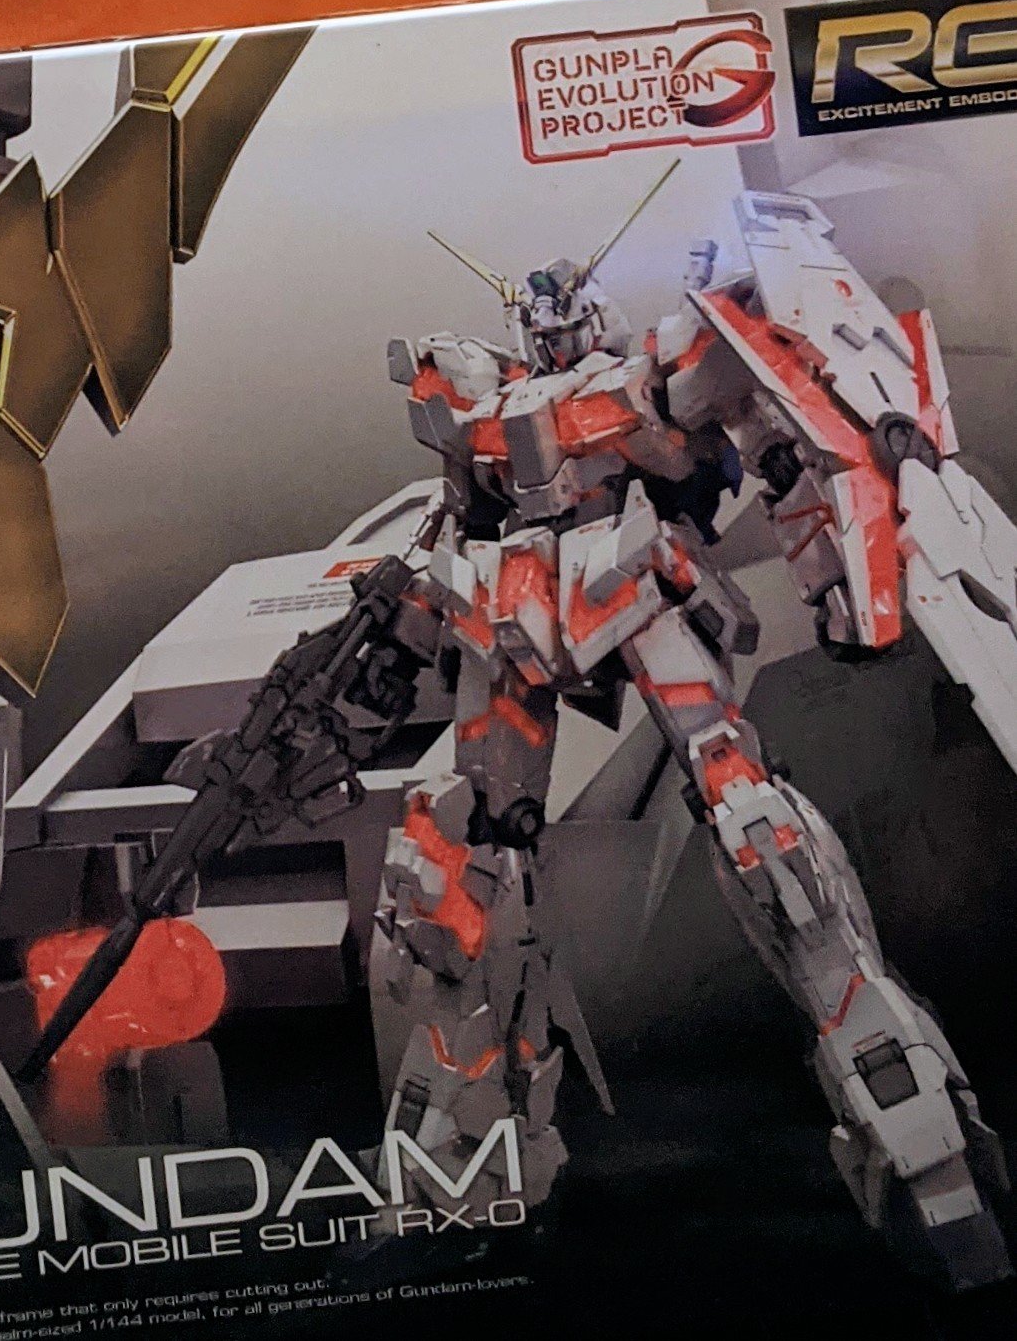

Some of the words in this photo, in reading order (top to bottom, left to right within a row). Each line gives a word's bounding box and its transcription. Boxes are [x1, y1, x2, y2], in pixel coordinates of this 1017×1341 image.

[534, 46, 672, 82] GUNPLA
[538, 71, 714, 111] EVOLUTION
[818, 97, 943, 122] EXCITEMENT
[541, 102, 685, 140] PROJECT
[38, 1230, 243, 1275] MOBILE
[259, 1213, 381, 1251] SUIT
[0, 1308, 54, 1324] frame
[60, 1302, 97, 1317] that
[104, 1299, 139, 1312] only
[145, 1291, 220, 1309] requires
[225, 1282, 288, 1299] cutting
[294, 1277, 330, 1293] out.
[89, 1315, 143, 1332] 1/144
[213, 1305, 239, 1318] for
[245, 1301, 262, 1315] all
[268, 1292, 371, 1314] generations
[376, 1287, 393, 1300] of
